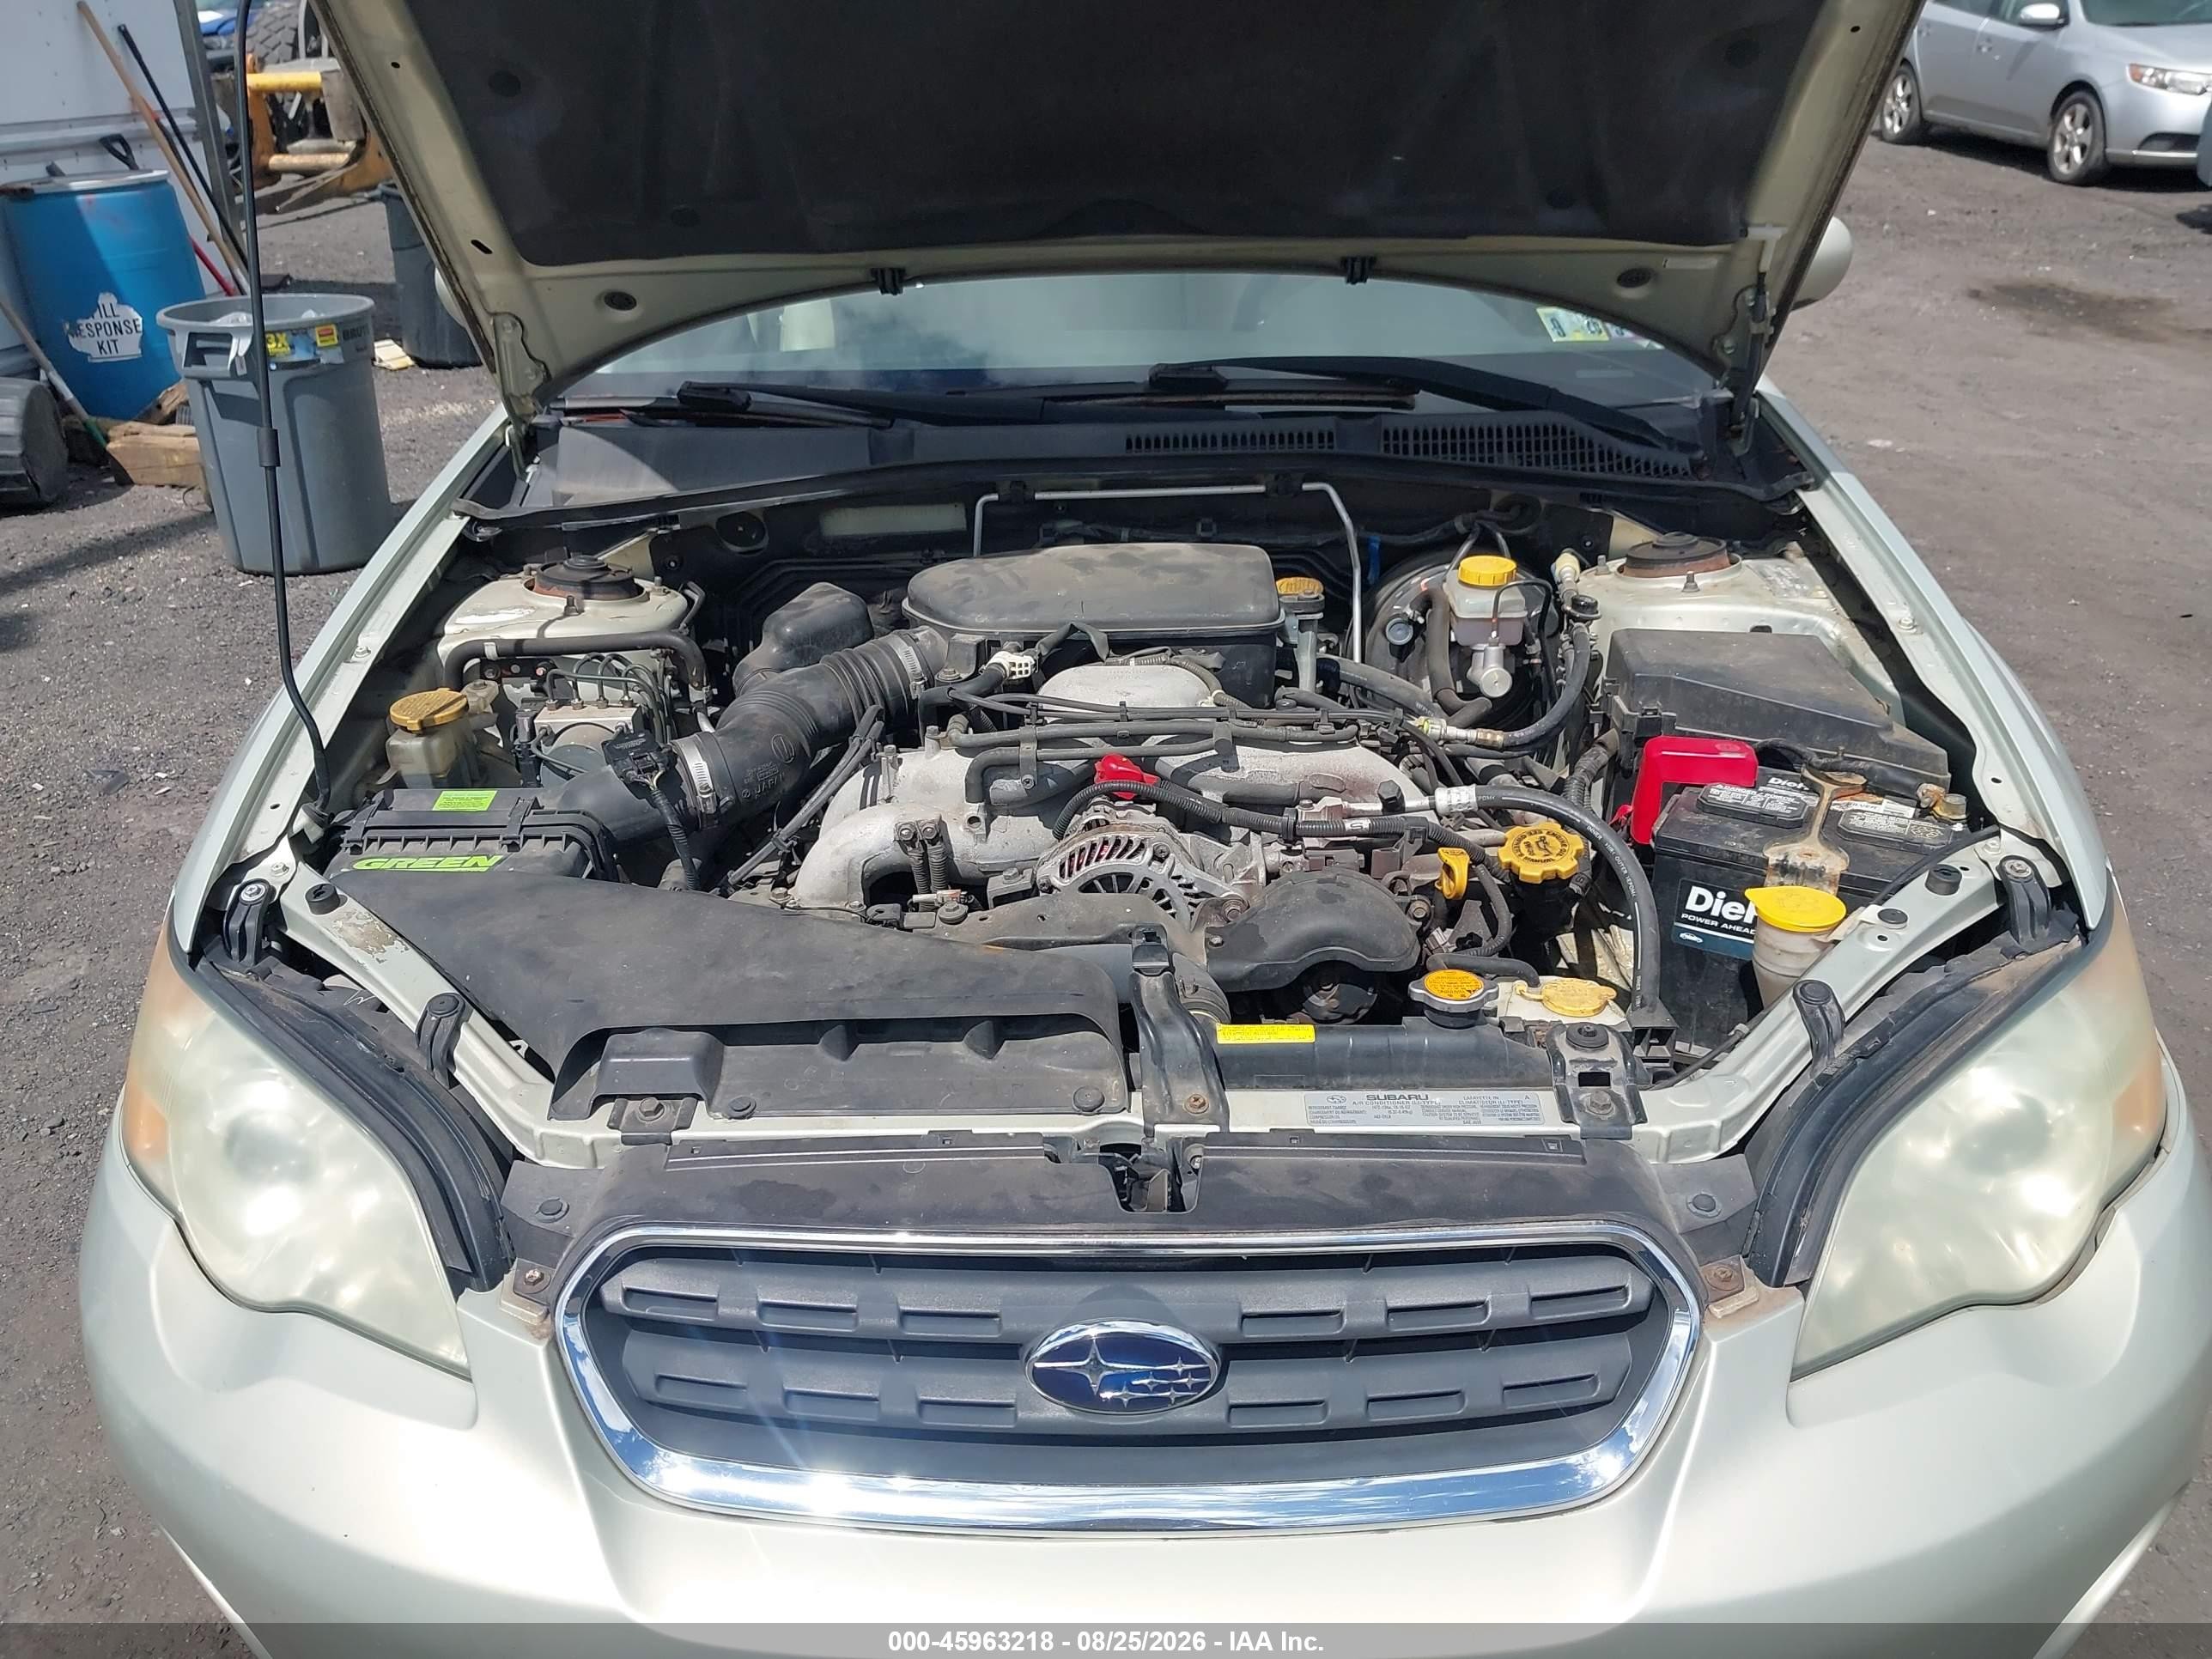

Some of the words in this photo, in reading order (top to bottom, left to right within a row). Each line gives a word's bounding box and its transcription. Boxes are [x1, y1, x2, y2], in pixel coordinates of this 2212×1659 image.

[95, 303, 120, 319] ILL
[97, 339, 118, 355] KIT
[1547, 830, 1567, 848] ENGINE
[353, 855, 503, 870] GREEN
[1615, 856, 1628, 874] OUTER
[1680, 913, 1718, 927] POWER
